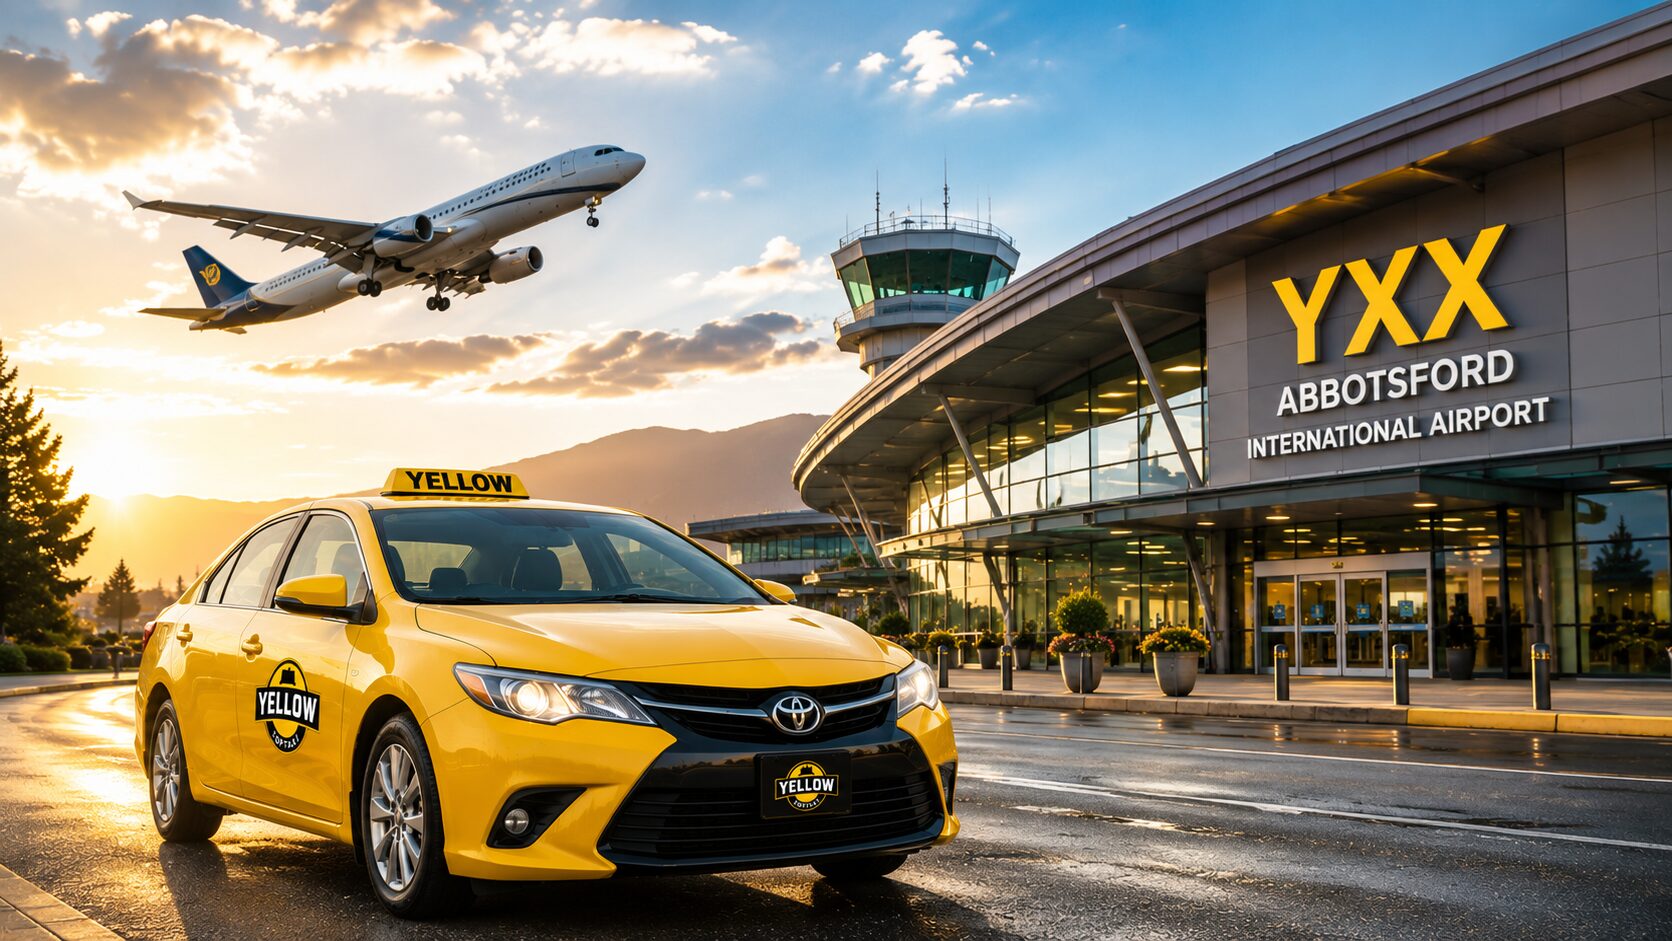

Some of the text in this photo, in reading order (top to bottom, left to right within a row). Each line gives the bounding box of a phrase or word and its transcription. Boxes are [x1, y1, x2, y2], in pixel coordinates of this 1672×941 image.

[1271, 223, 1511, 364] YXX
[1276, 349, 1515, 417] ABBOTSFORD
[1247, 397, 1550, 459] INTERNATIONAL AIRPORT
[405, 471, 512, 493] YELLOW
[258, 691, 317, 723] YELLOW
[779, 778, 834, 795] YELLOW
